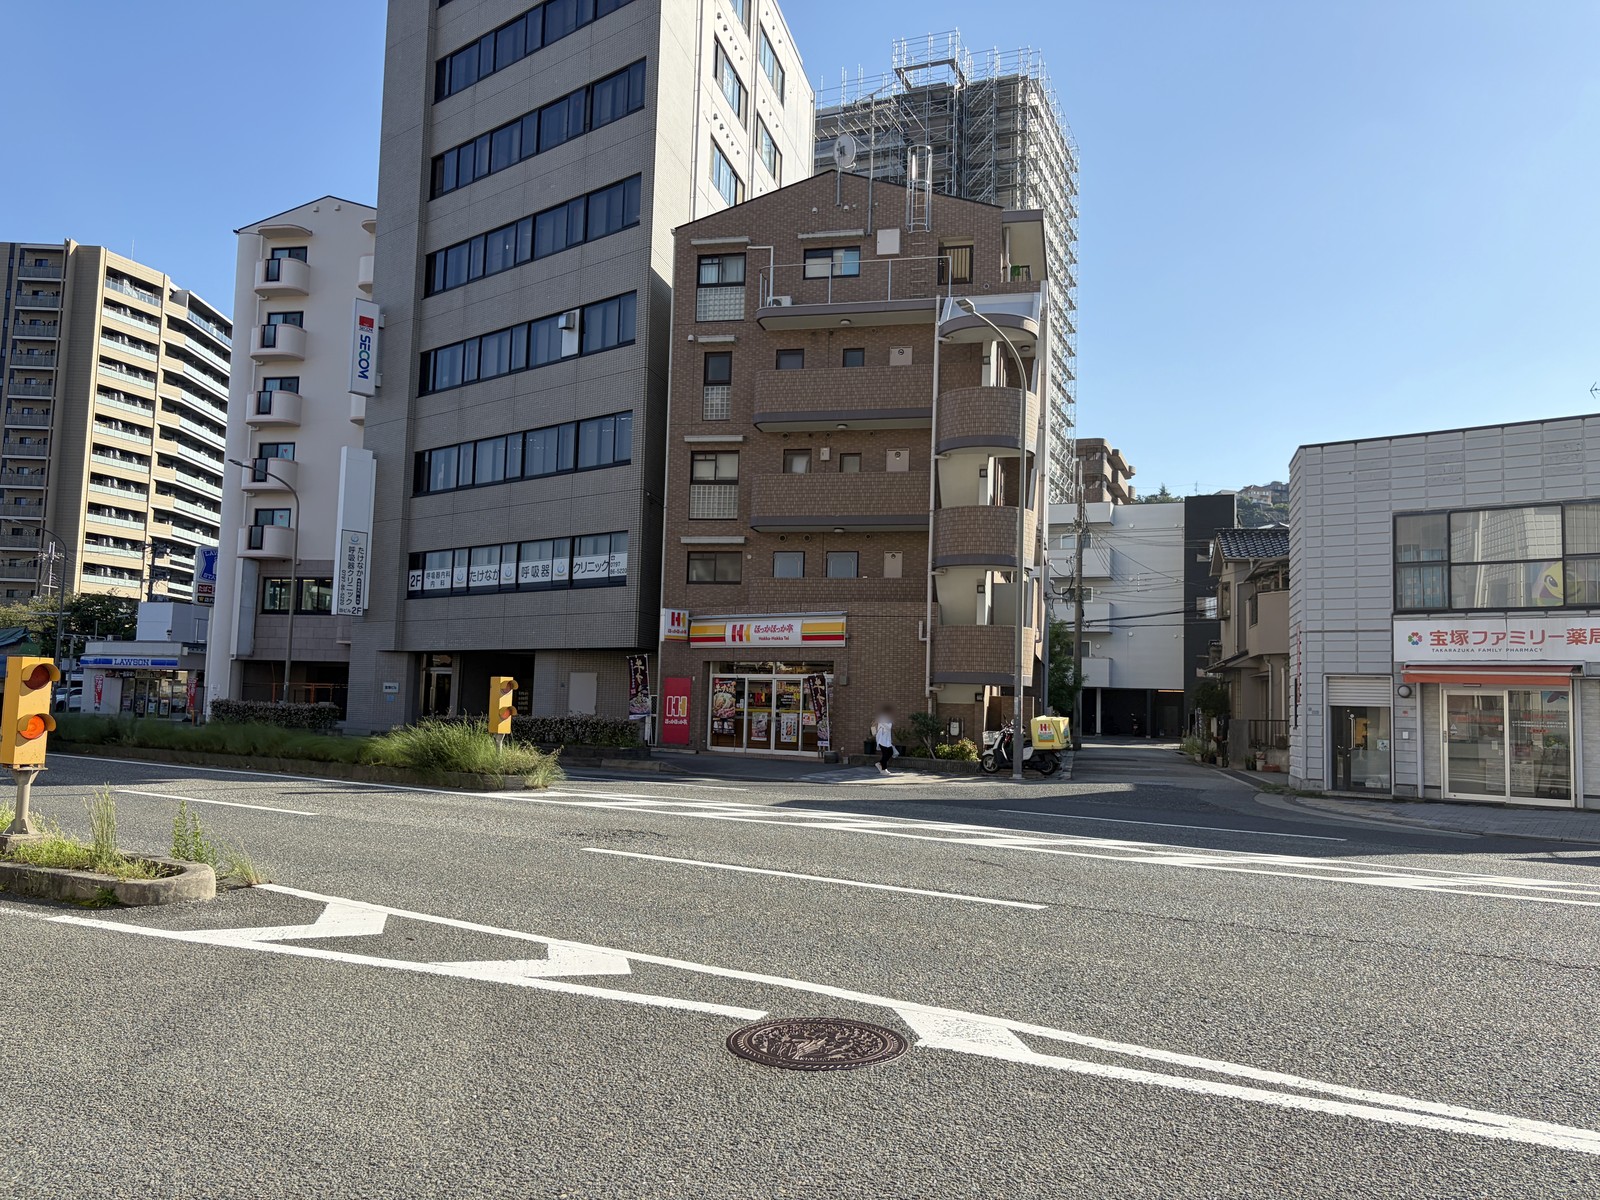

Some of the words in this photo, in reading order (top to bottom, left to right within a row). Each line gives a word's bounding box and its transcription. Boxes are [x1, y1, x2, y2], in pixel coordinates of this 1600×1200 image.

[358, 334, 371, 380] SECOM
[356, 547, 365, 577] たけなか
[346, 546, 356, 606] 呼吸器クリニック
[426, 570, 450, 580] 呼吸器内科
[469, 568, 500, 583] たけなか
[521, 564, 550, 579] 呼吸器
[573, 559, 610, 574] クリニック
[410, 574, 421, 588] 2F
[351, 606, 362, 614] 2F
[754, 623, 794, 634] ほっかほっか亭
[113, 658, 151, 667] LAWSON
